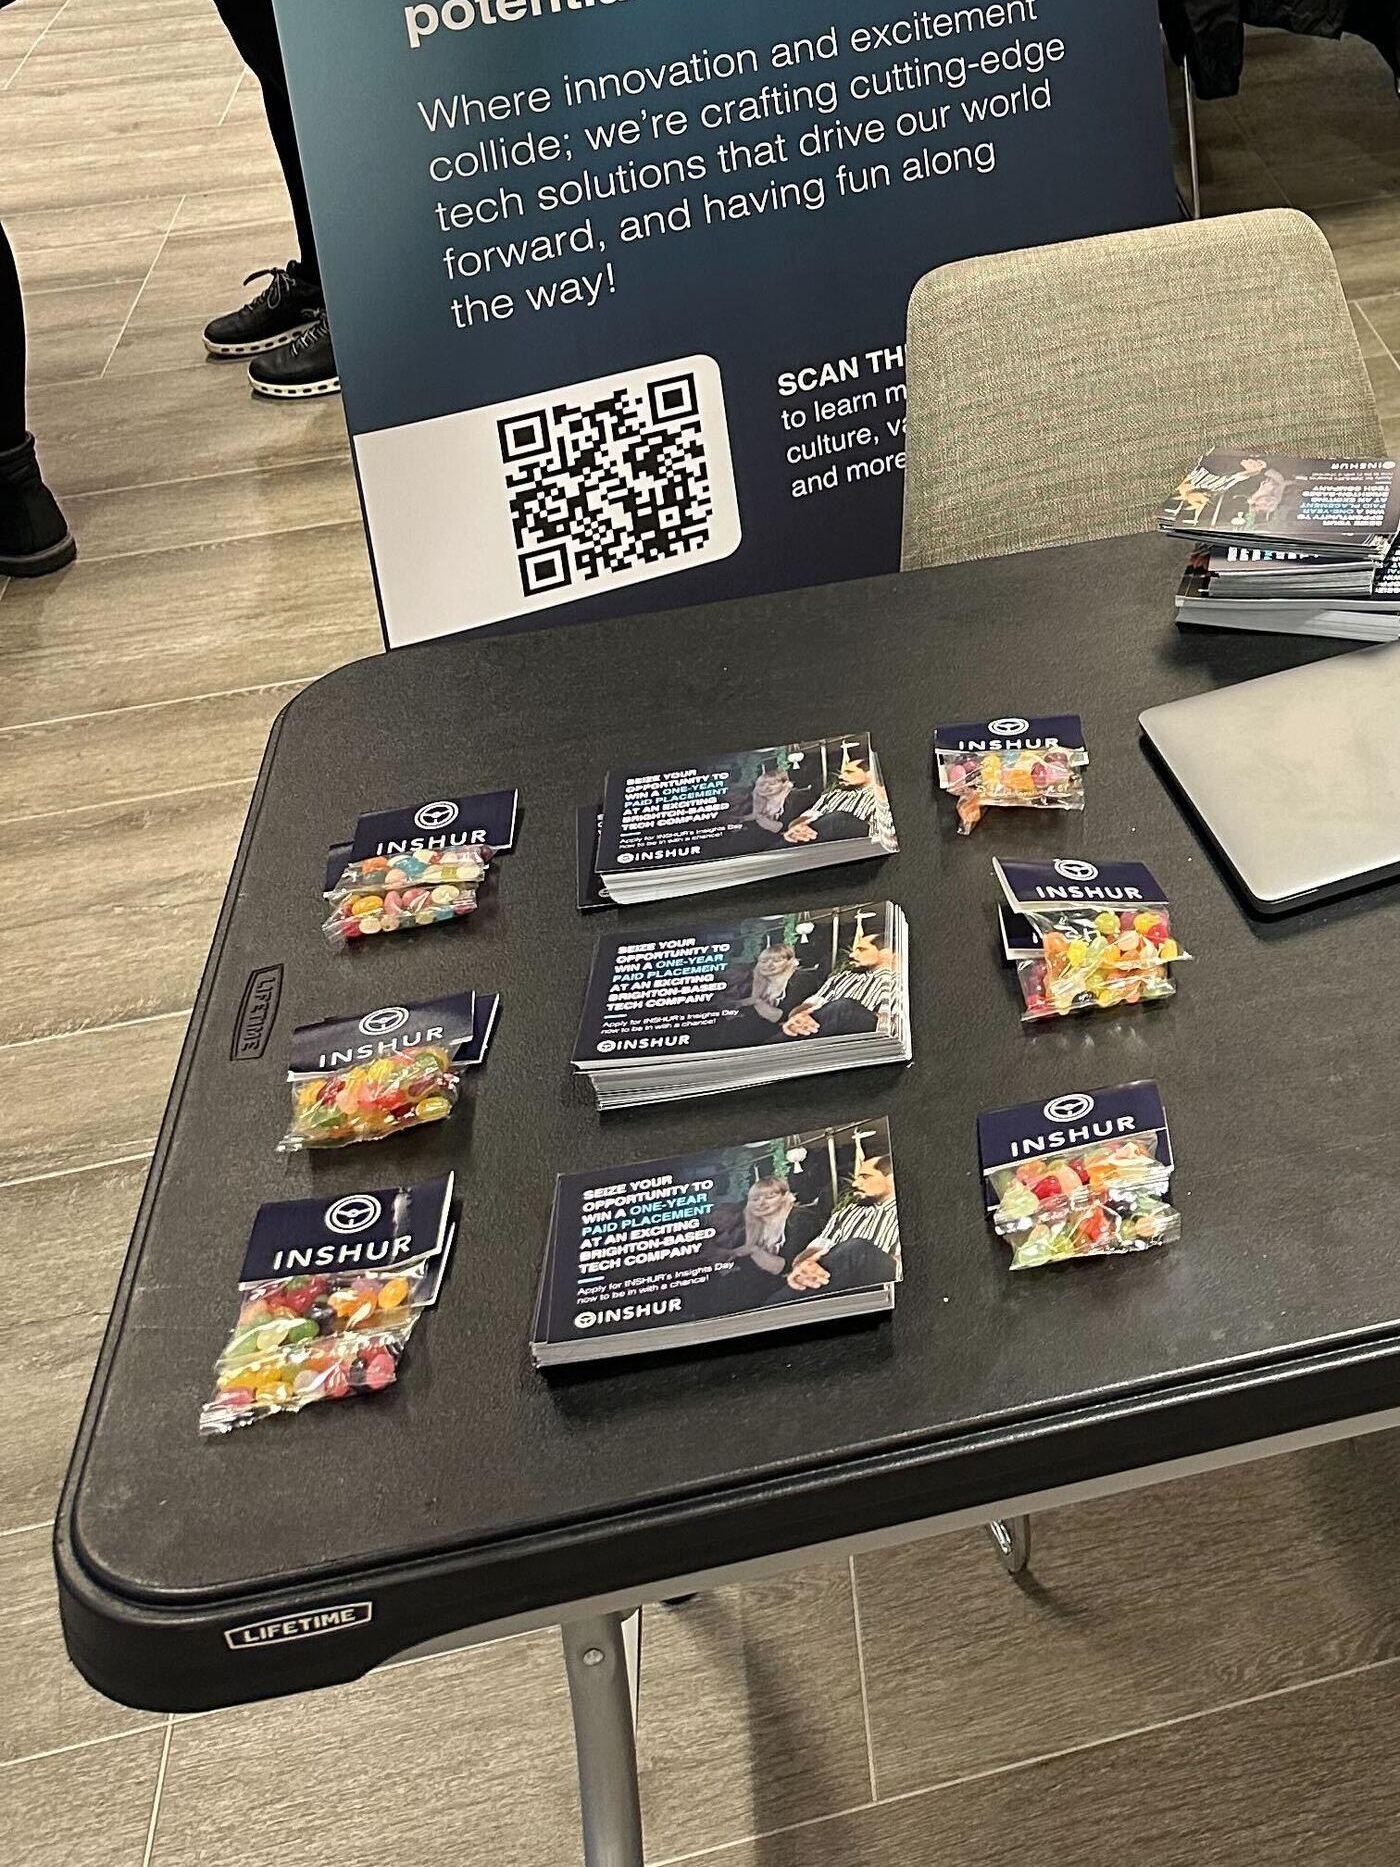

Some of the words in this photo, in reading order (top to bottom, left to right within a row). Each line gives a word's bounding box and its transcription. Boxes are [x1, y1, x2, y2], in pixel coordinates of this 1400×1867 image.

[417, 87, 551, 132] Where
[563, 49, 758, 106] innovation
[771, 26, 838, 68] and
[429, 131, 572, 182] collide;
[584, 109, 688, 151] we're
[701, 81, 838, 128] crafting
[850, 38, 1065, 99] cutting-edge
[434, 187, 524, 232] tech
[537, 155, 707, 211] solutions
[716, 134, 789, 174] that
[799, 119, 885, 157] drive
[896, 105, 951, 136] our
[960, 82, 1051, 123] world
[442, 218, 606, 280] forward,
[620, 198, 691, 242] and
[703, 177, 825, 224] having
[835, 164, 891, 196] fun
[903, 143, 995, 182] along
[450, 294, 514, 328] the
[525, 262, 616, 311] way!
[777, 356, 859, 396] SCAN
[781, 410, 807, 431] to
[813, 391, 877, 423] learn
[786, 427, 879, 464] culture,
[791, 464, 838, 498] and
[846, 451, 906, 483] more
[958, 737, 1061, 752] INSHUR
[376, 829, 487, 856] INSHUR
[634, 845, 701, 861] INSHUR
[1035, 885, 1143, 900] INSHUR
[241, 976, 276, 1052] LIFETIME
[319, 1026, 443, 1068] INSHUR
[616, 1034, 690, 1051] INSHUR
[1011, 1116, 1136, 1157] INSHUR
[582, 1183, 627, 1201] SEIZE
[629, 1174, 673, 1192] YOUR
[582, 1183, 690, 1213] OPPORTUNITY
[691, 1179, 714, 1192] TO
[581, 1210, 612, 1225] WIN
[614, 1208, 627, 1219] A
[629, 1192, 708, 1216] ONE-YEAR
[581, 1222, 618, 1237] PAID
[621, 1203, 715, 1230] PLACEMENT
[579, 1236, 603, 1250] AT
[603, 1231, 628, 1246] AN
[629, 1218, 700, 1241] EXCITING
[579, 1227, 717, 1263] BRIGHTON-BASED
[273, 1235, 412, 1271] INSHUR
[578, 1257, 622, 1274] TECH
[623, 1242, 703, 1267] COMPANY
[577, 1285, 607, 1296] Apply
[608, 1282, 623, 1290] for
[674, 1265, 713, 1279] Insights
[714, 1261, 735, 1272] Day
[597, 1298, 682, 1324] INSHUR
[244, 1608, 356, 1643] LIFETIME
